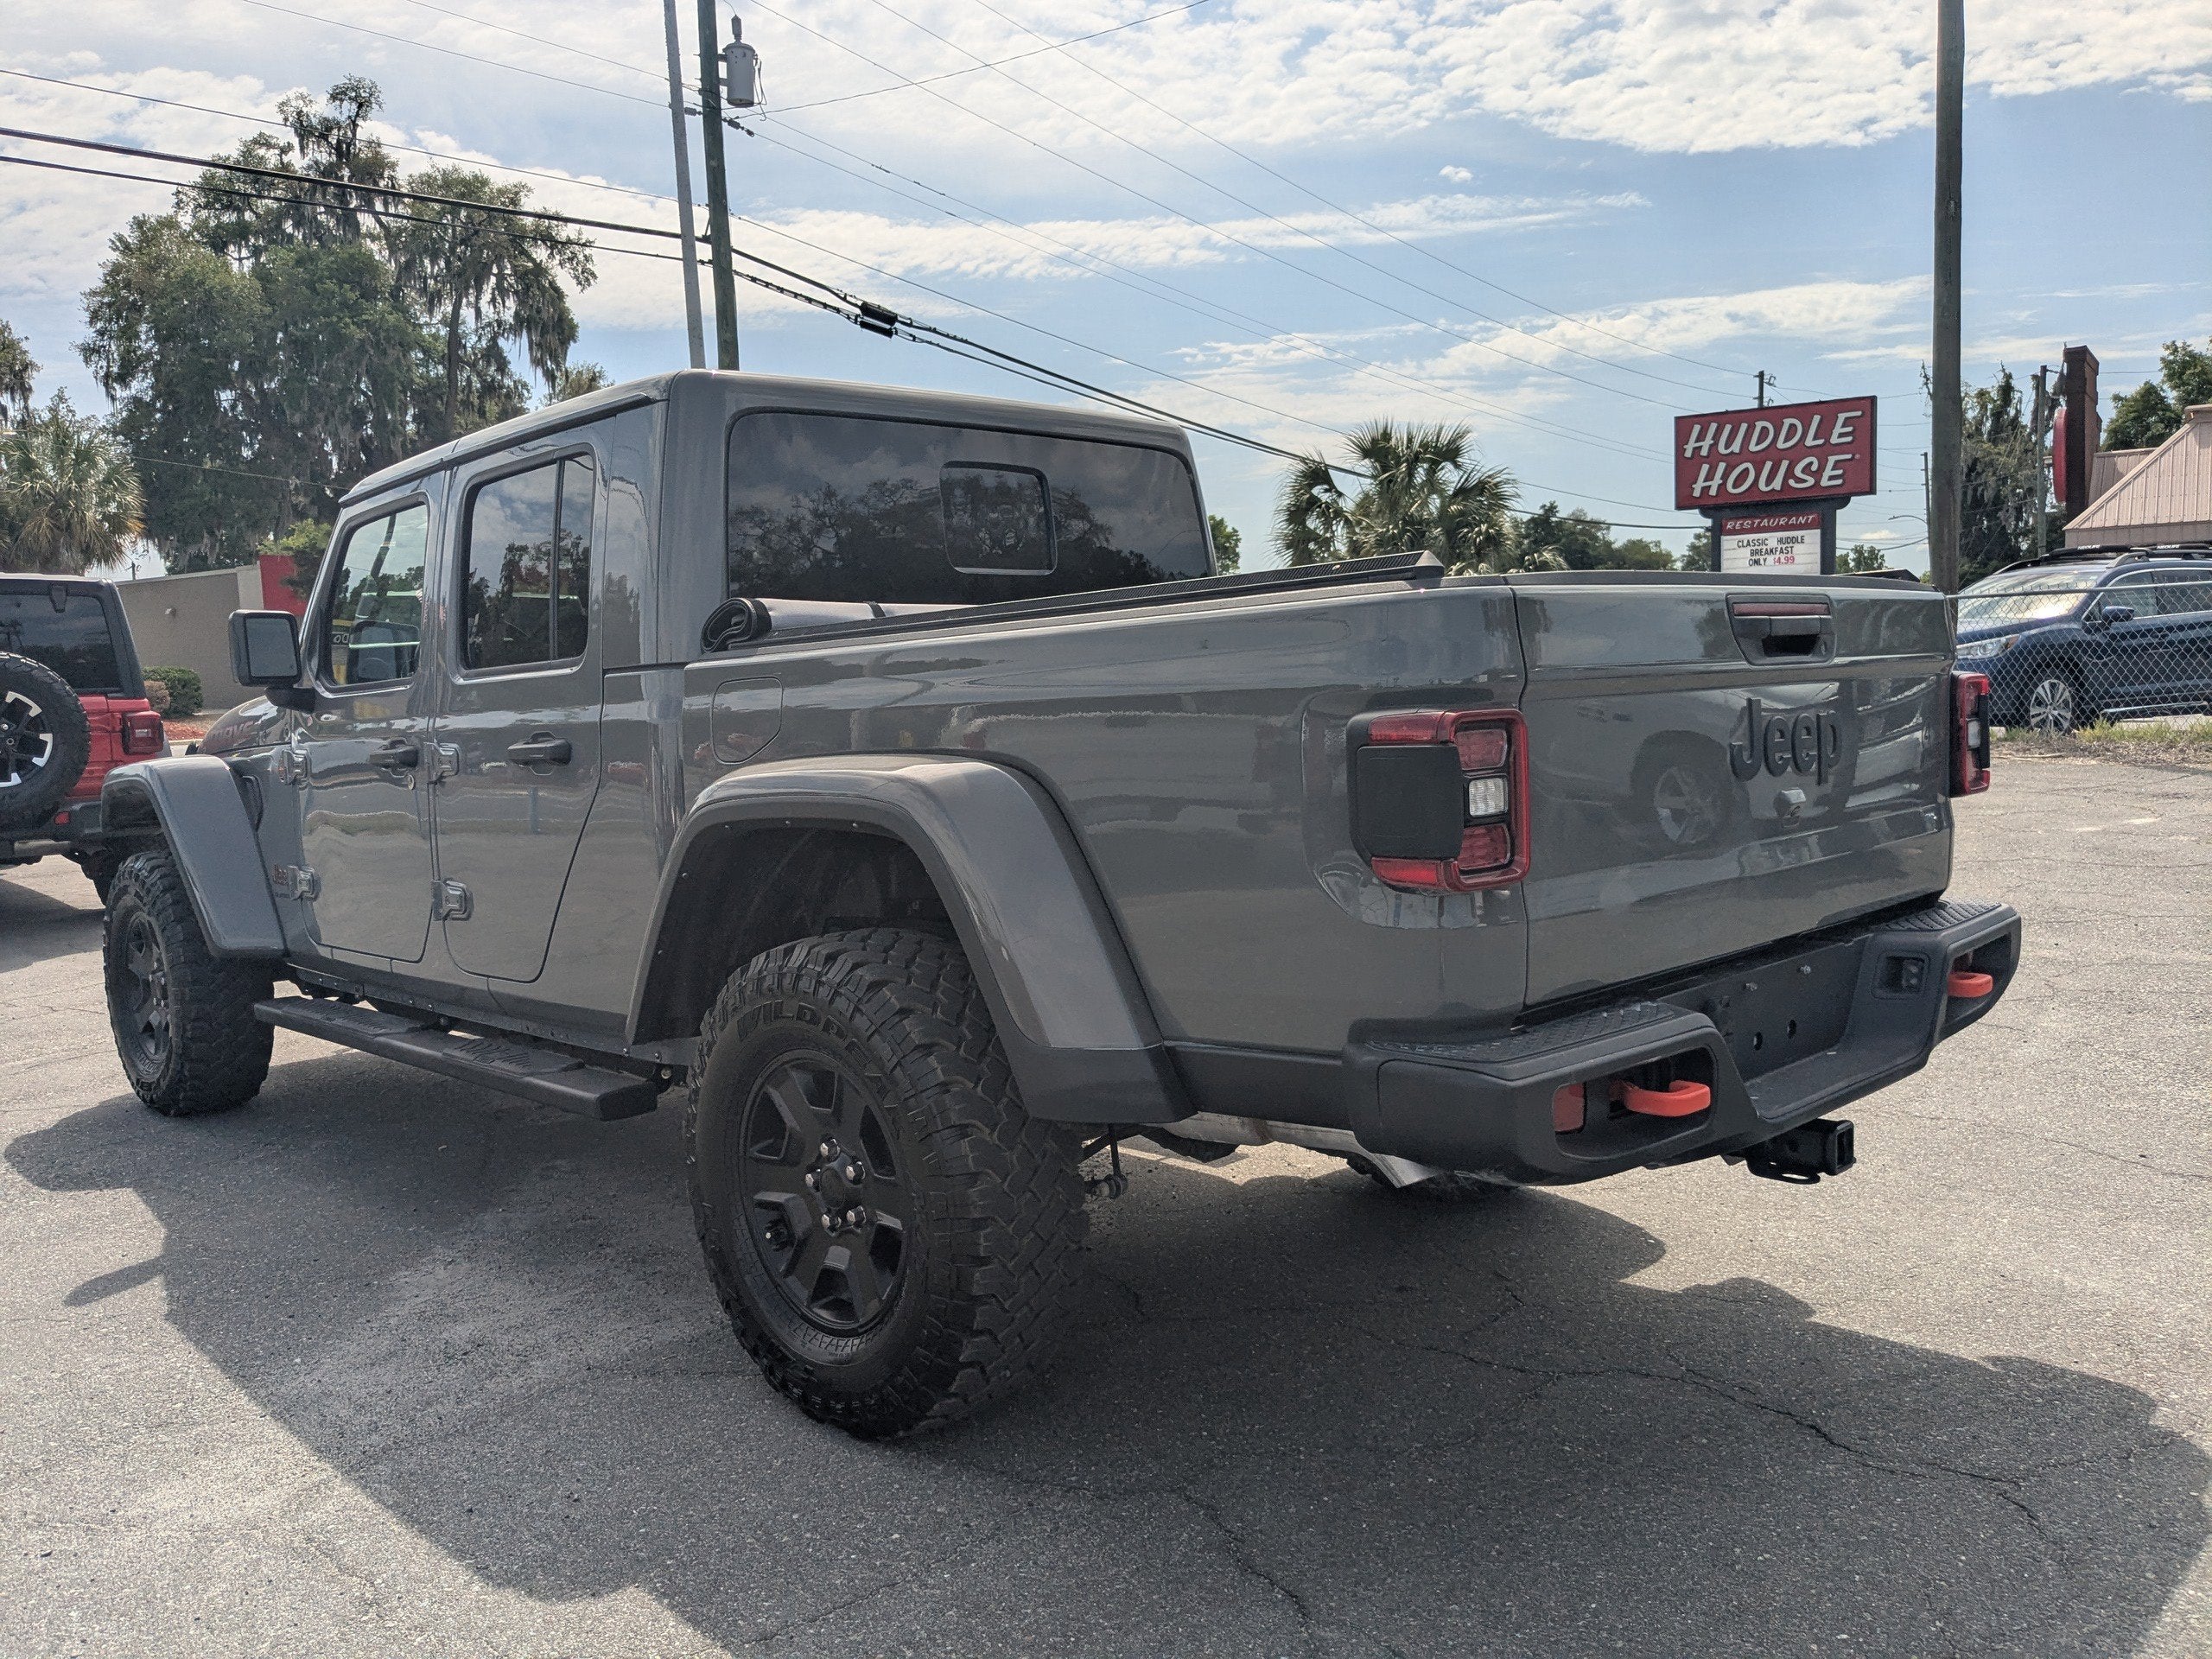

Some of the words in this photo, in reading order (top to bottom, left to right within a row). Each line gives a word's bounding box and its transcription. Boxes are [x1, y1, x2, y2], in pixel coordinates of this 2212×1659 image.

[1683, 410, 1862, 458] HUDDLE
[1692, 454, 1852, 498] HOUSE
[1726, 515, 1815, 530] RESTAURANT
[1737, 537, 1769, 548] CLASSIC
[1777, 536, 1805, 545] HUDDLE
[1750, 546, 1794, 556] BREAKFAST
[1748, 557, 1767, 567] ONLY
[1773, 556, 1795, 565] $4.99
[1730, 697, 1842, 785] Jeep
